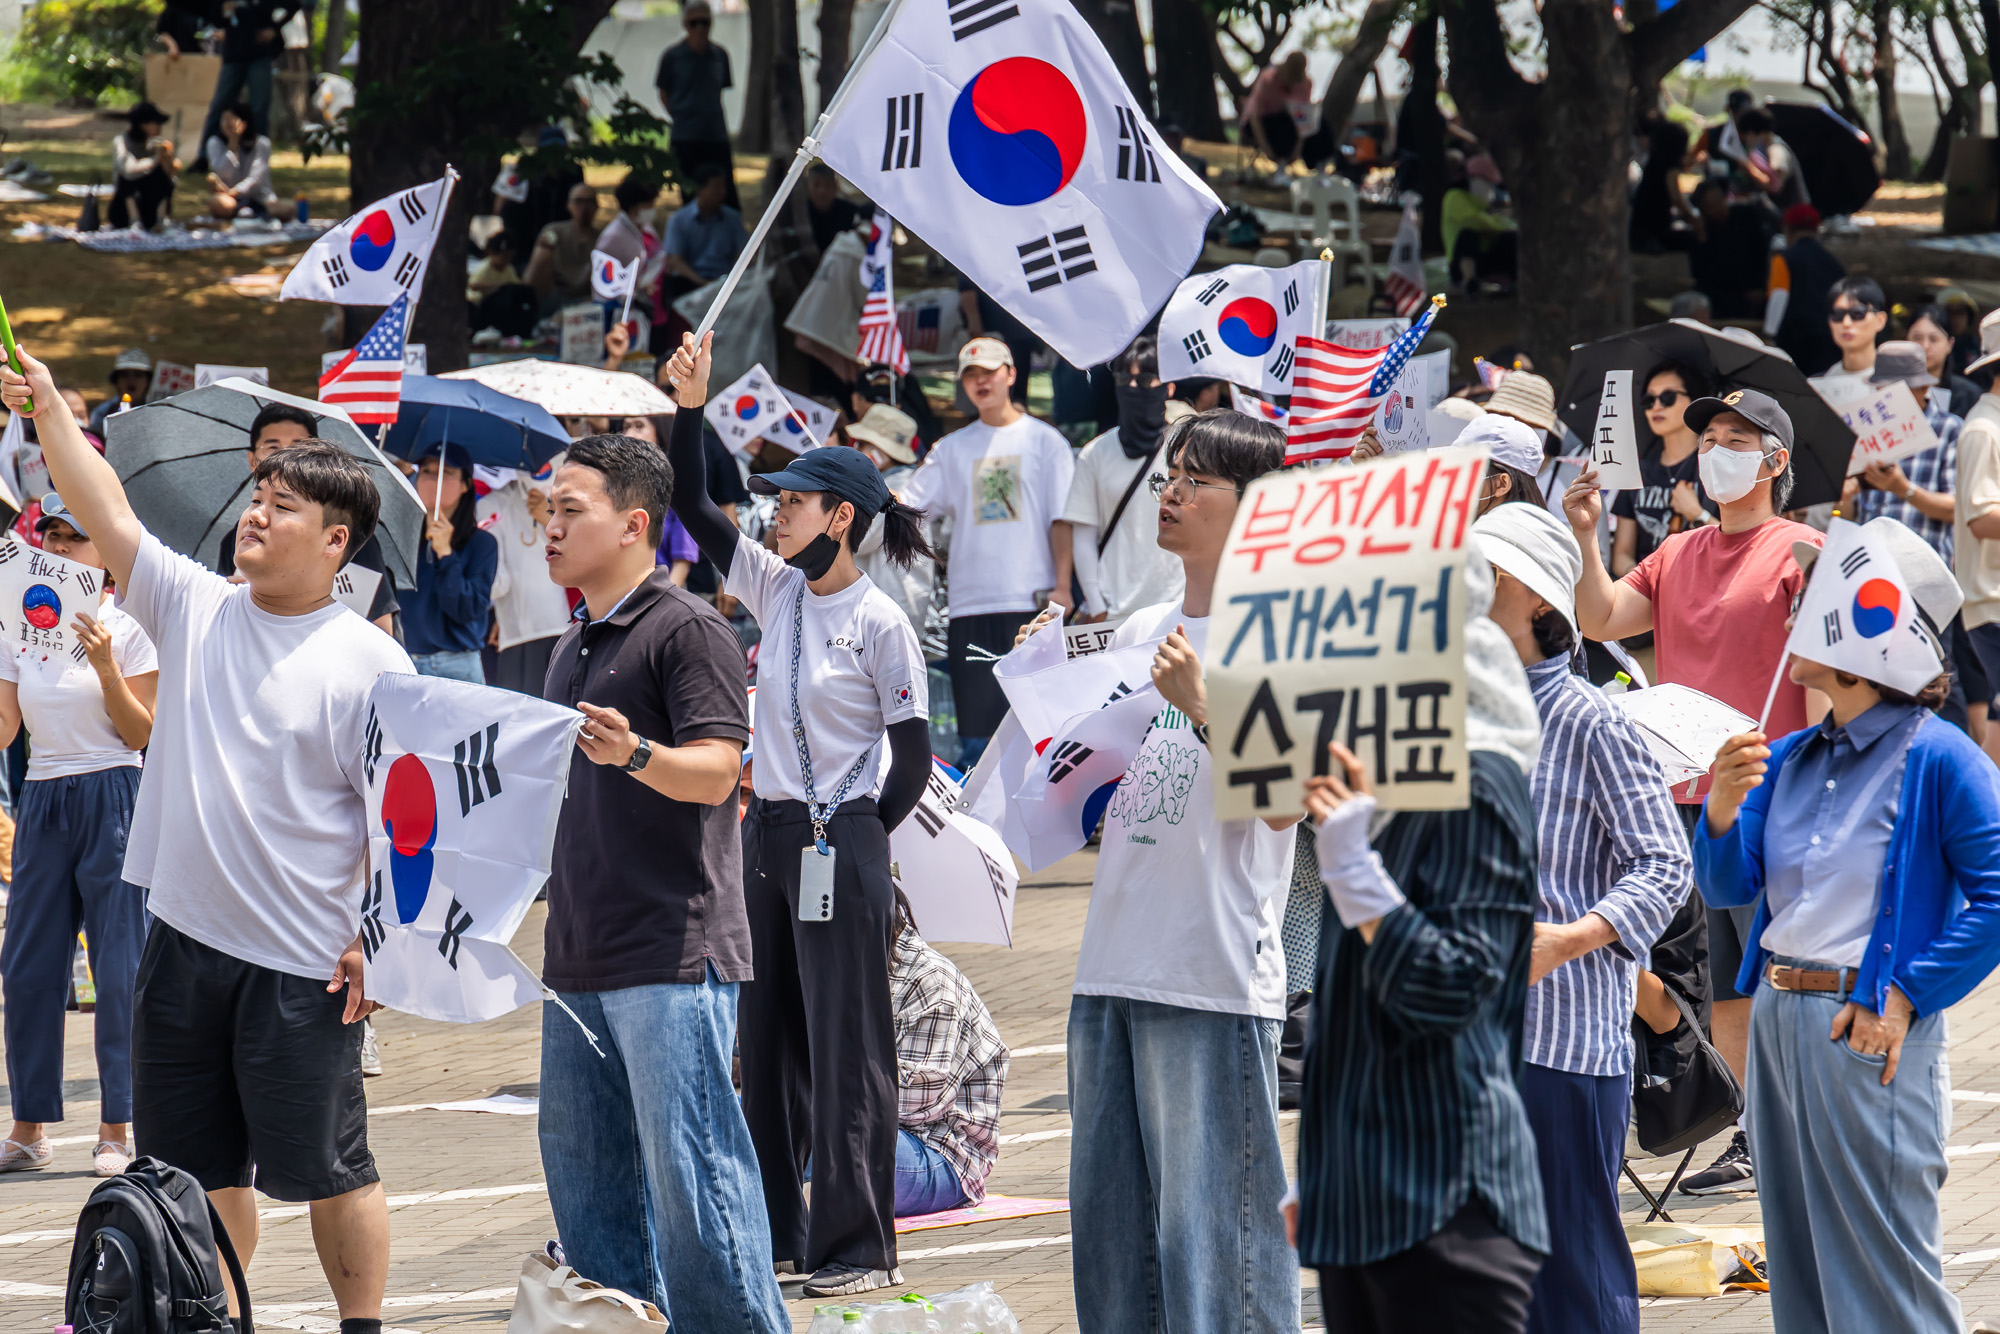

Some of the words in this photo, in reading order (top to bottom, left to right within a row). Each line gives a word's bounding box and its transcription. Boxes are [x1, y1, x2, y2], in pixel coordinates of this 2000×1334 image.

[1234, 458, 1482, 573] 부정선거
[28, 550, 69, 584] 수개표
[1221, 566, 1454, 667] 재선거
[20, 622, 64, 651] 당일투표
[1228, 678, 1456, 808] 수개표
